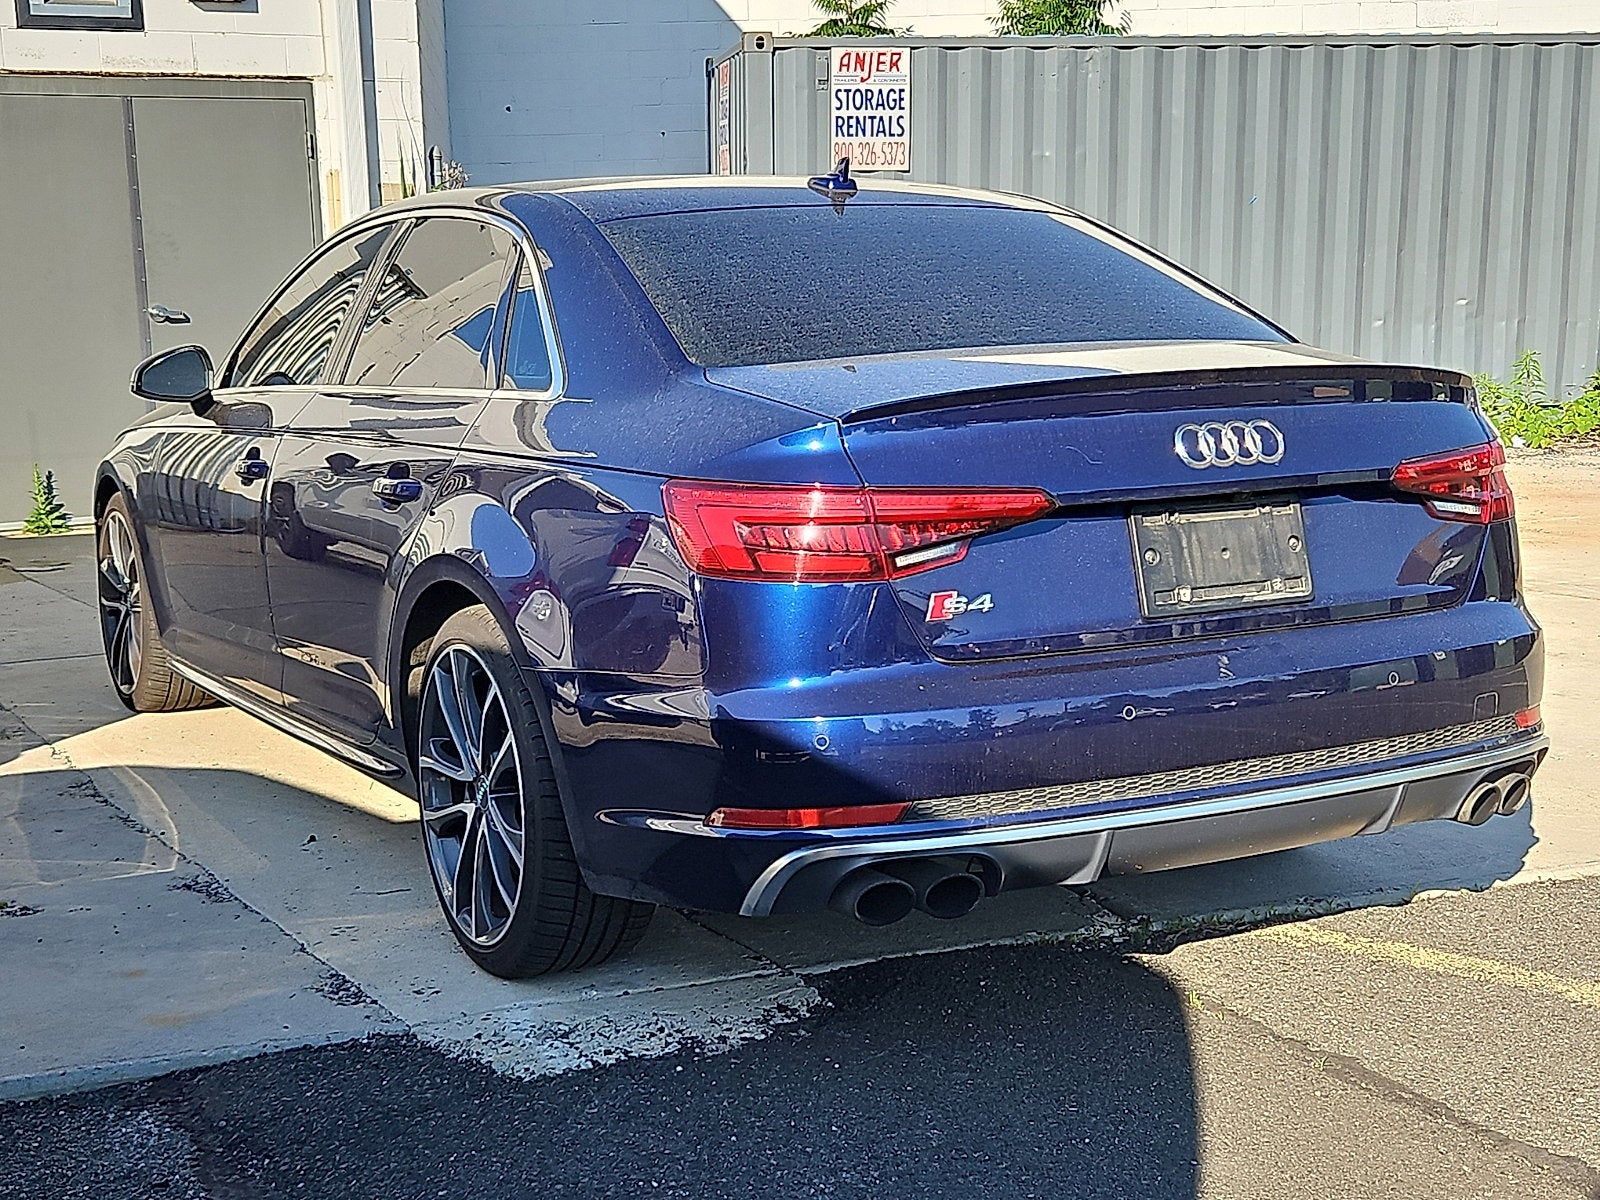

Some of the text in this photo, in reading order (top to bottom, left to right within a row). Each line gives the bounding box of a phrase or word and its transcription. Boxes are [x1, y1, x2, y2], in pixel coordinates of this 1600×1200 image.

[838, 52, 902, 83] ANJER
[834, 88, 906, 111] STORAGE
[835, 115, 905, 138] RENTALS
[833, 141, 906, 165] 800-326-5373
[938, 592, 995, 617] S4
